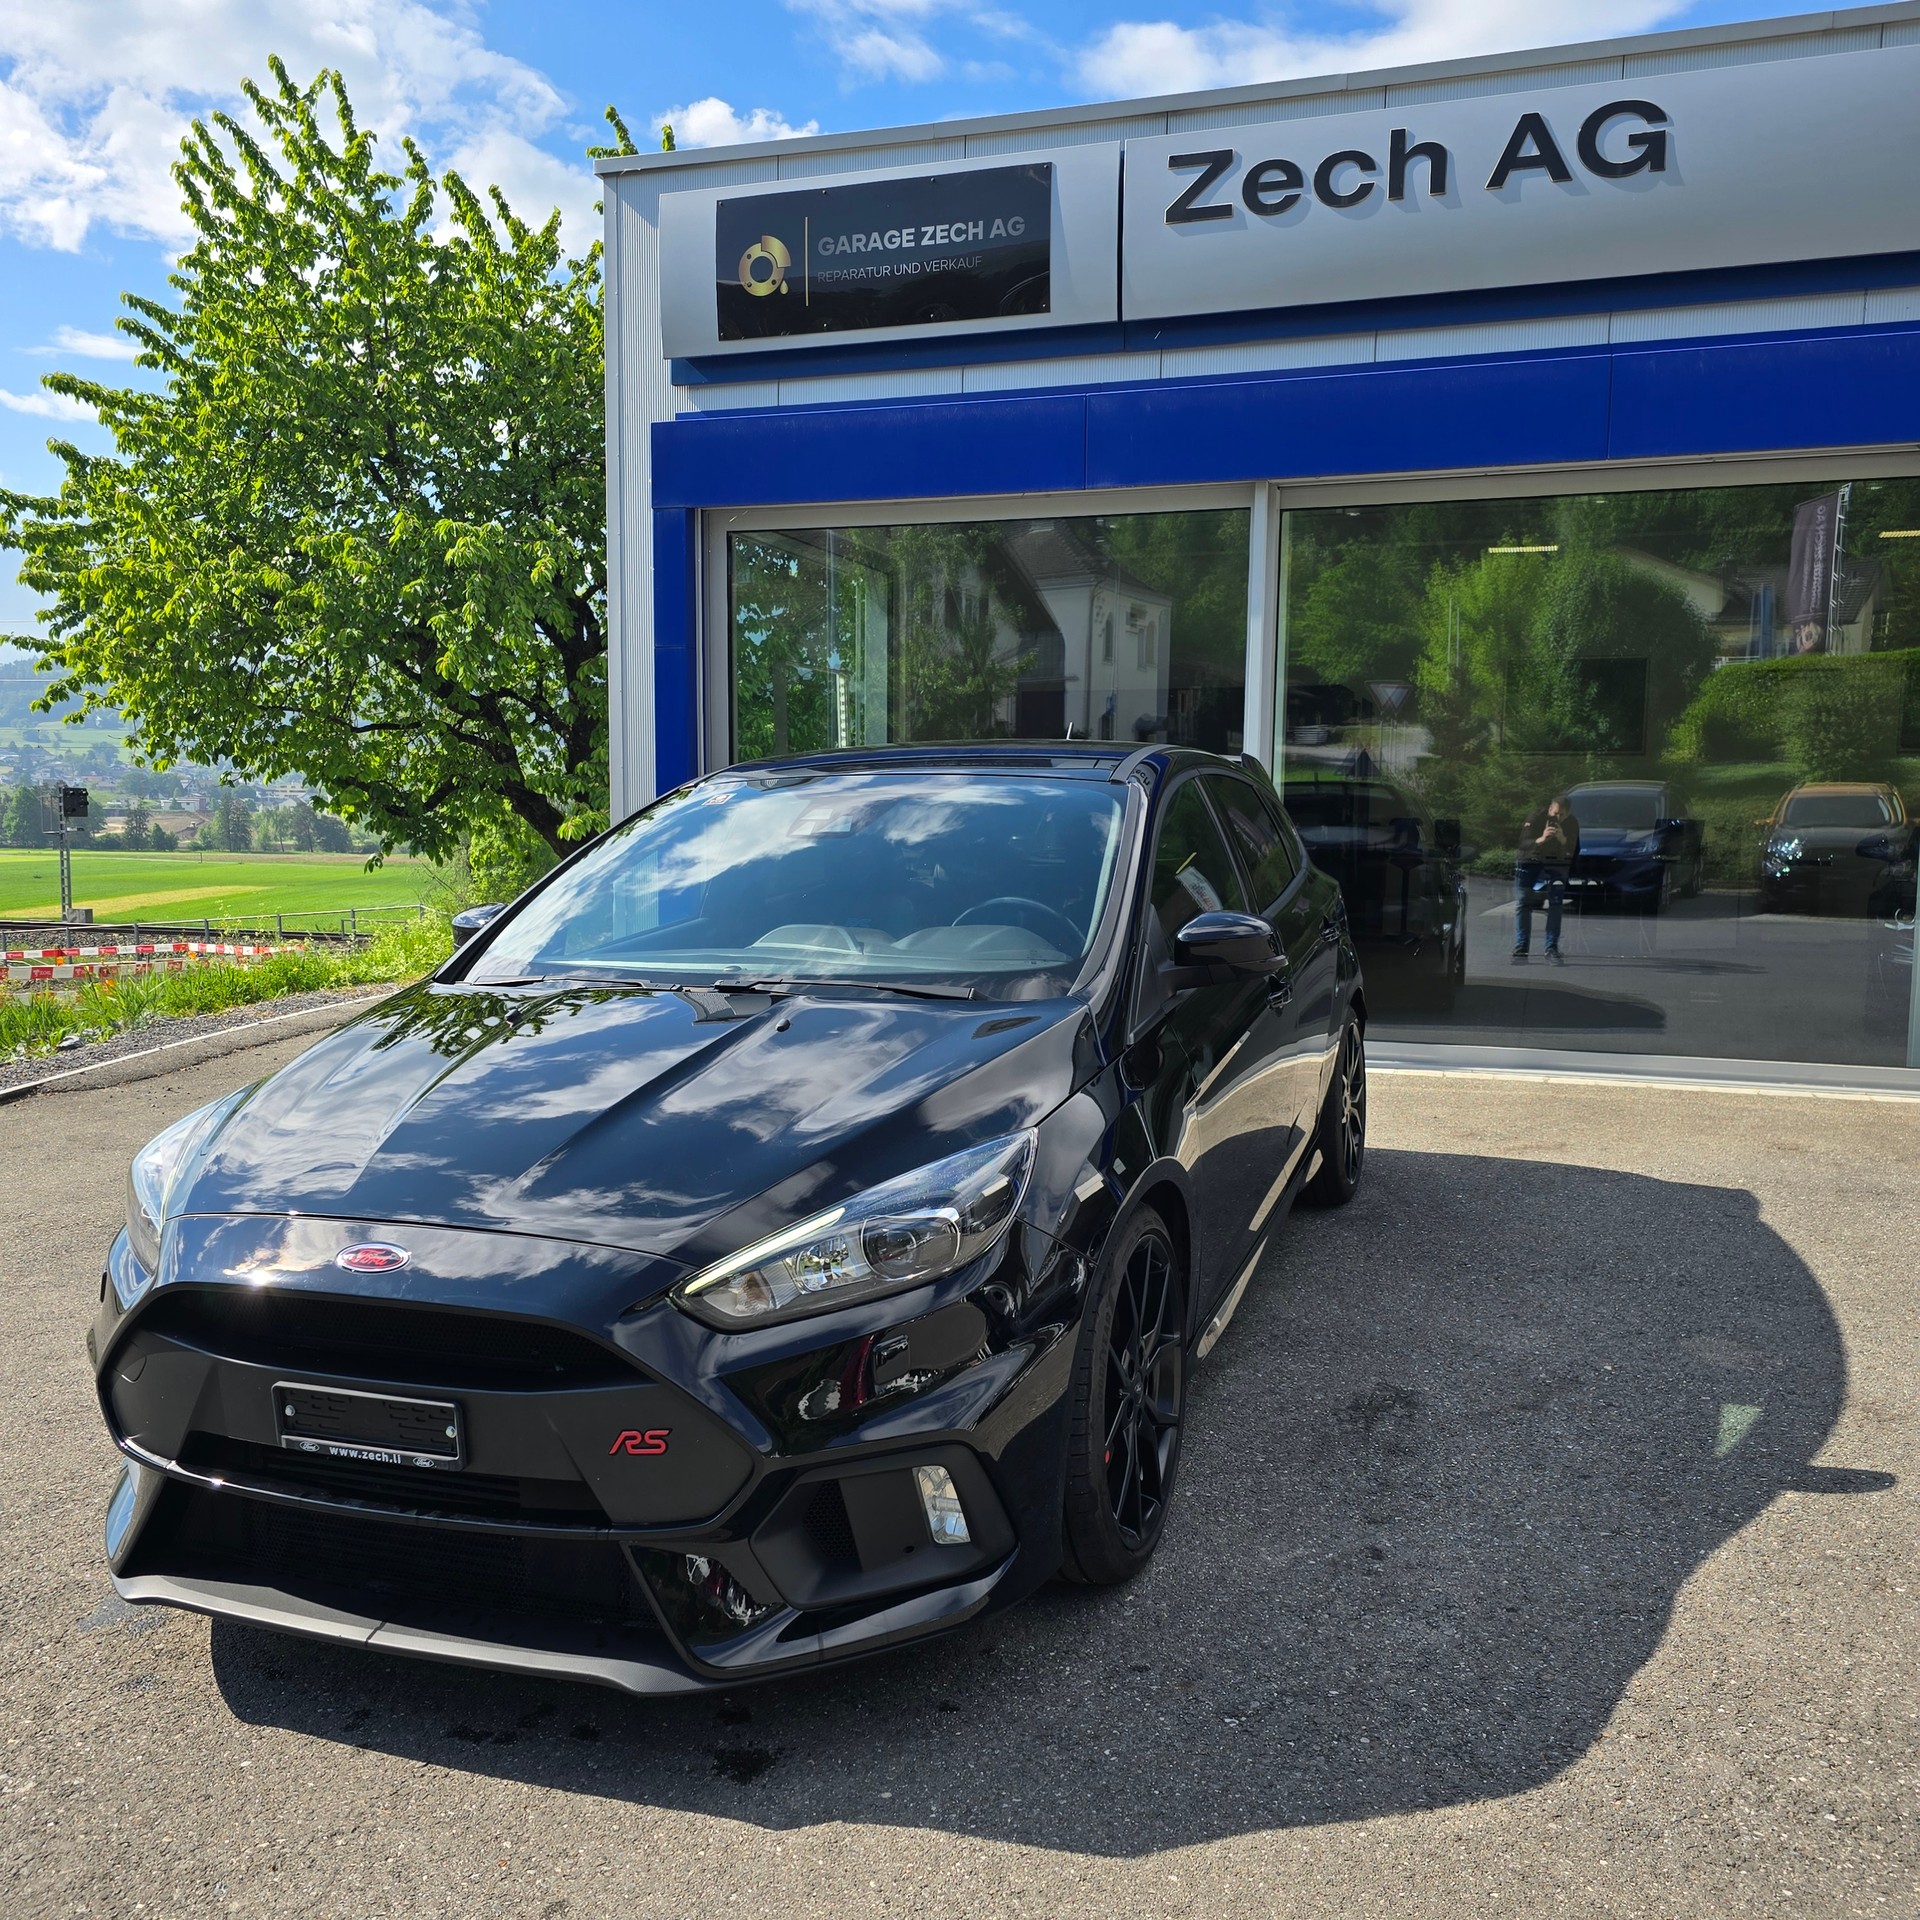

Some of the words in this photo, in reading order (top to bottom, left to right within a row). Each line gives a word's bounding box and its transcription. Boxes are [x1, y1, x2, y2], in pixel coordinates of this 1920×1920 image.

[1164, 128, 1448, 225] Zech
[1484, 99, 1668, 191] AG
[817, 227, 916, 256] GARAGE
[920, 220, 984, 246] ZECH
[989, 216, 1026, 239] AG
[817, 265, 891, 283] REPARATUR
[894, 262, 921, 276] UND
[924, 256, 983, 272] VERKAUF
[345, 1248, 397, 1267] Ford
[329, 1446, 402, 1464] www.zech.li
[608, 1429, 672, 1455] RS
